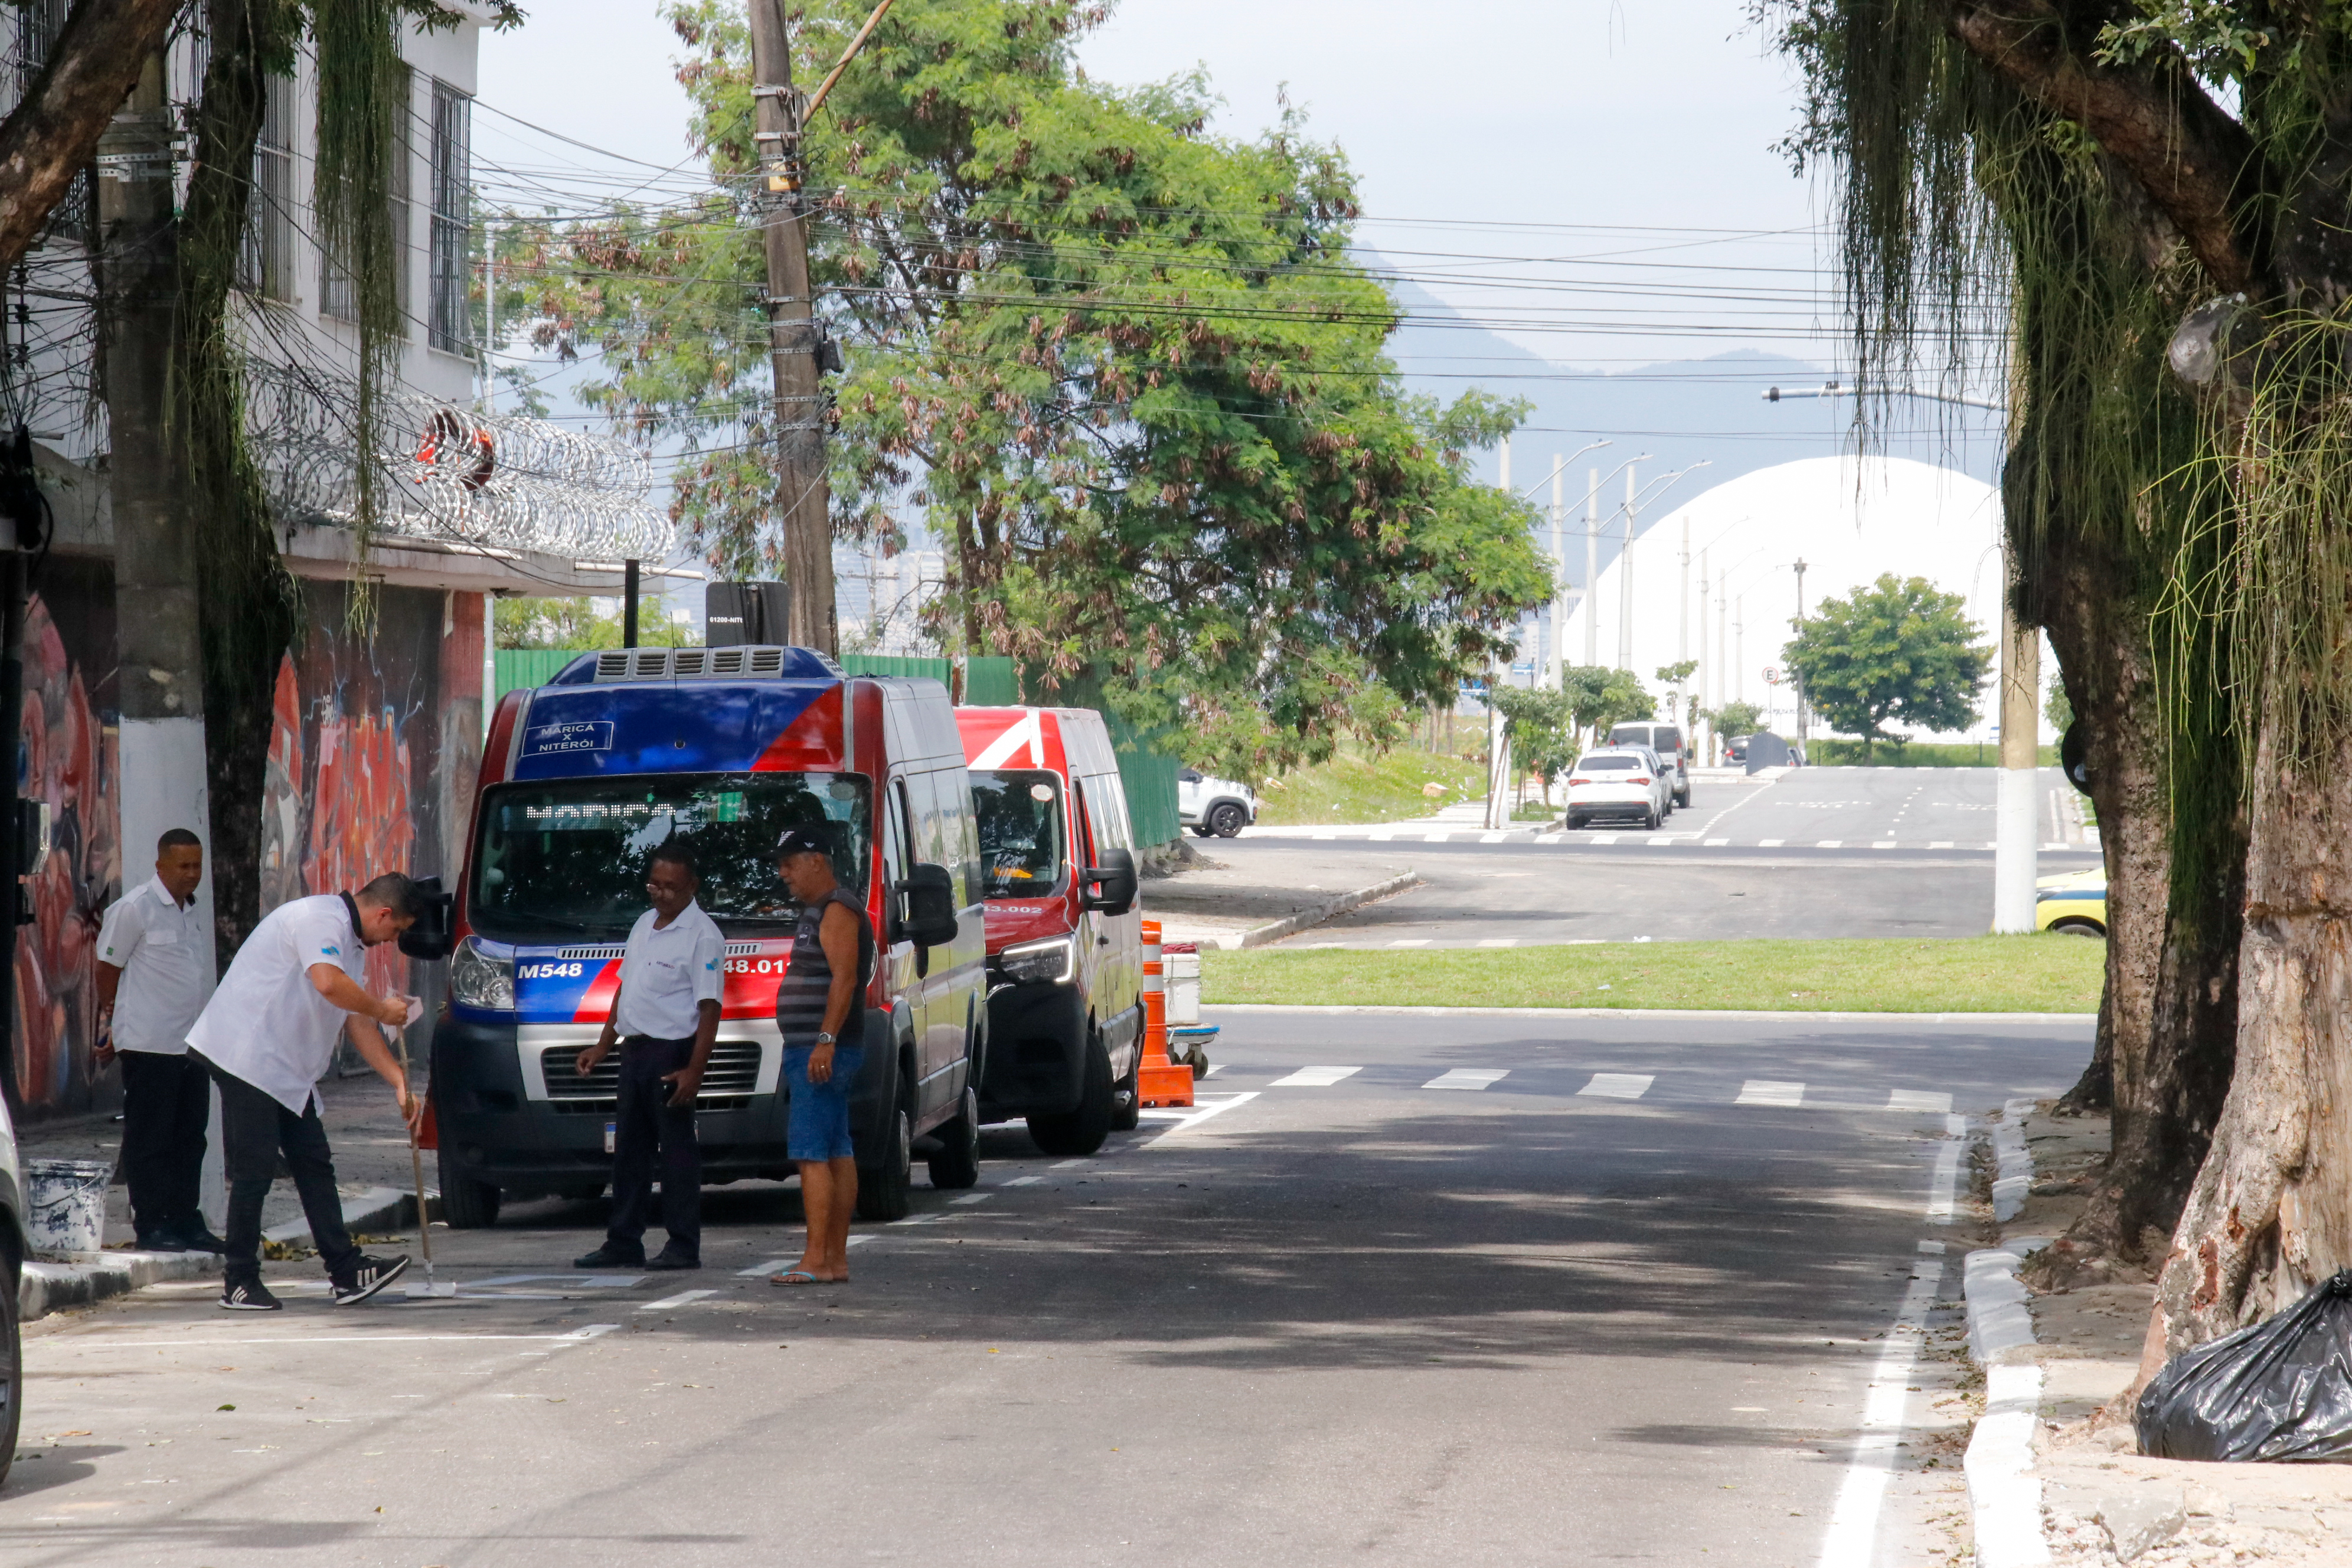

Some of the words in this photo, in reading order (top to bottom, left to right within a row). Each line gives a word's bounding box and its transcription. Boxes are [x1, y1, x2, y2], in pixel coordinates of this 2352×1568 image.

[1767, 670, 1773, 680] E
[541, 723, 594, 736] MARICÁ
[539, 739, 593, 752] NITERÓI
[518, 963, 582, 979] M548
[723, 959, 790, 974] 48.01
